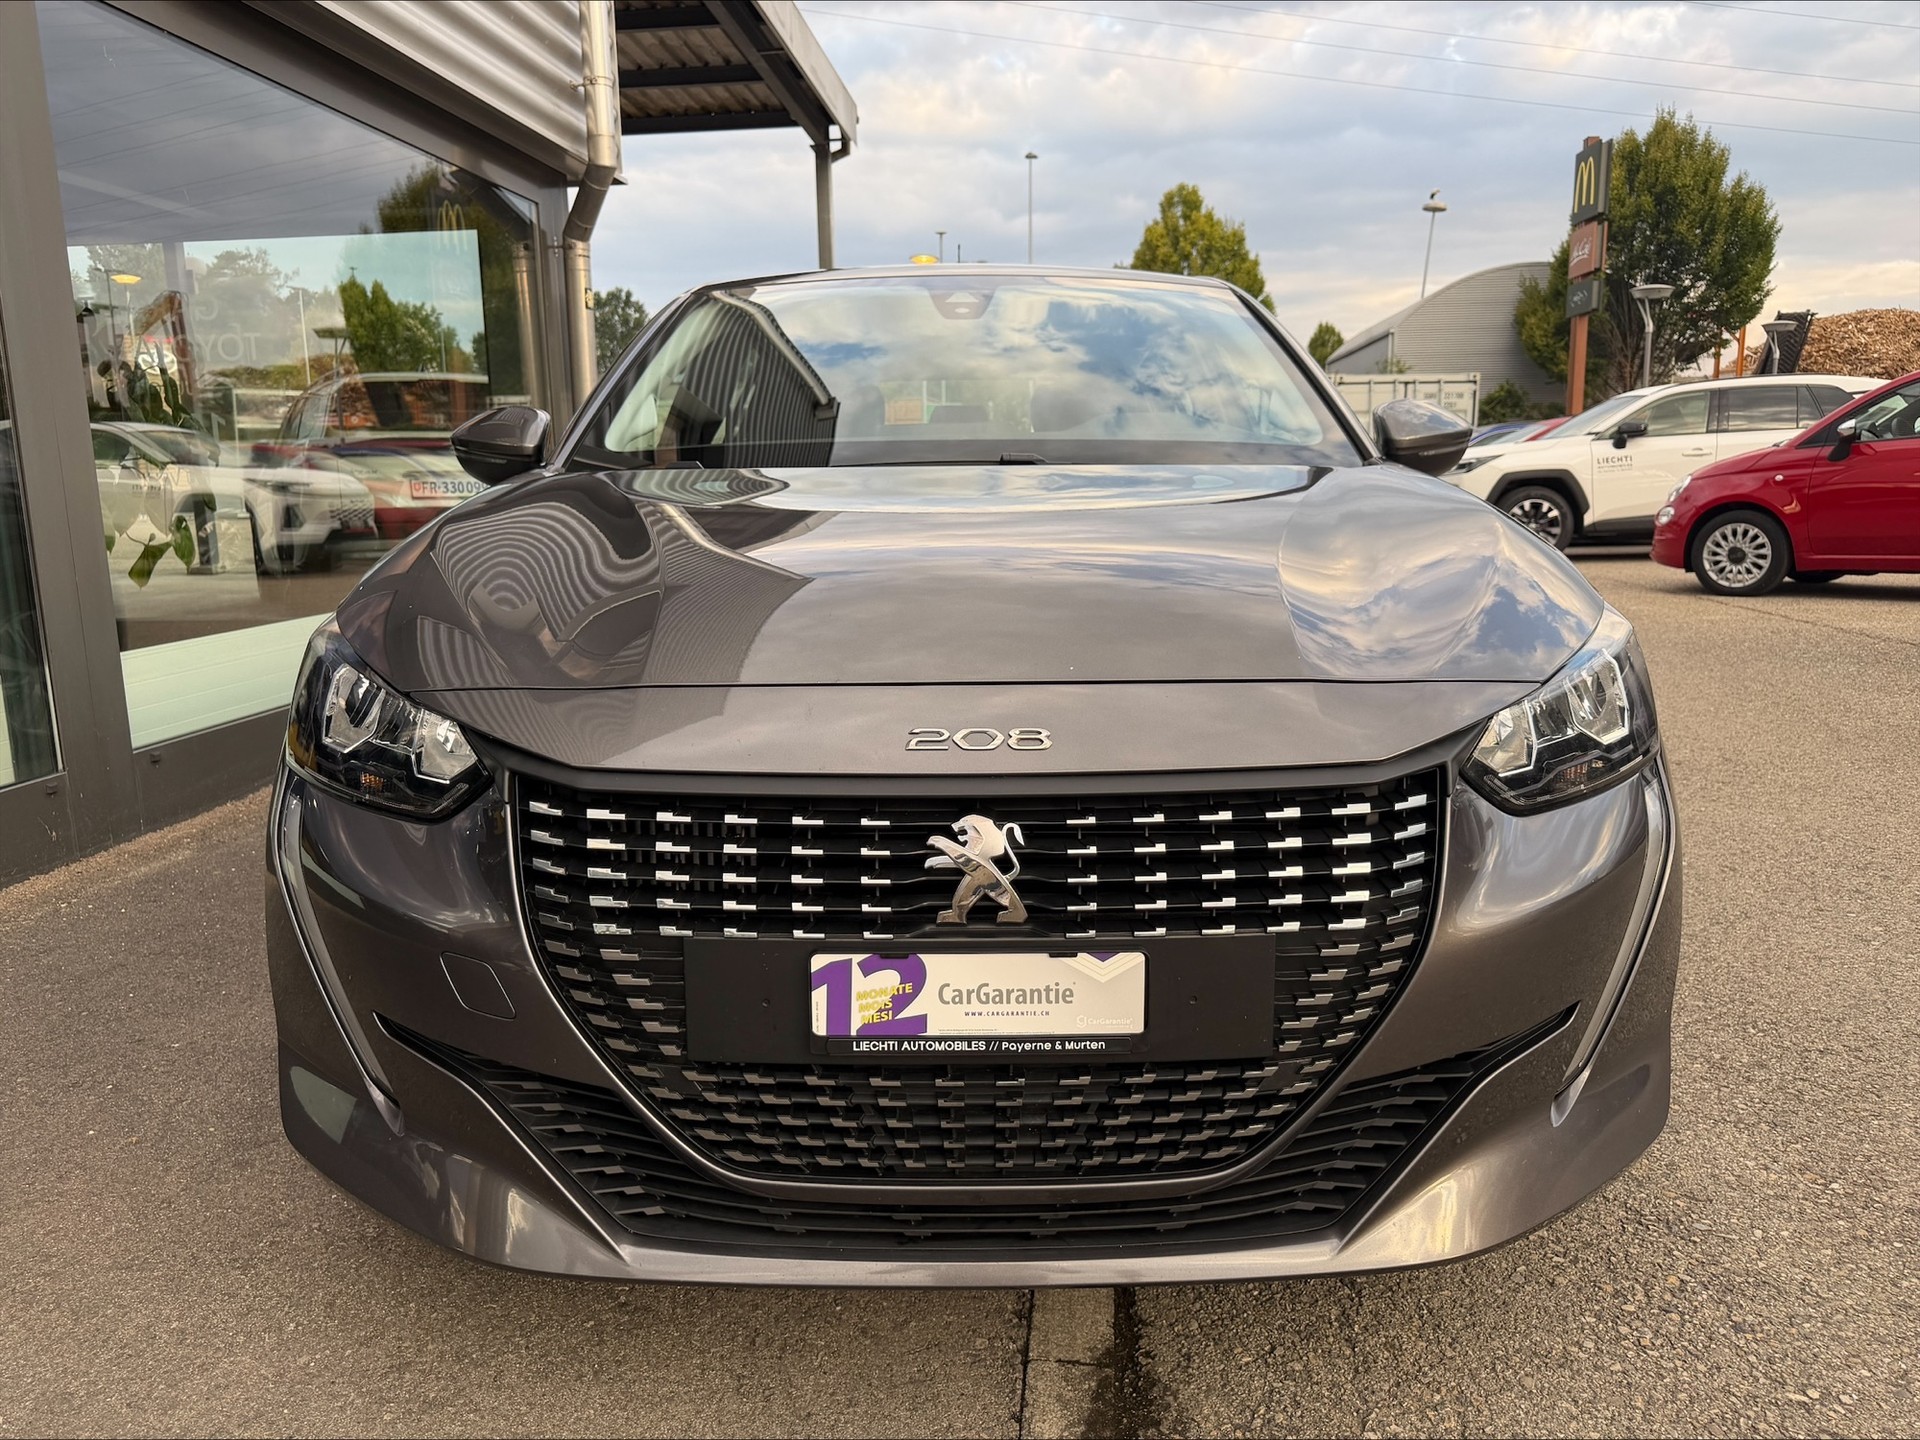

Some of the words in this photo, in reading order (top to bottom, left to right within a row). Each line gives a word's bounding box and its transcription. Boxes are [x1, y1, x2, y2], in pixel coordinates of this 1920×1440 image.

[1597, 455, 1633, 465] LIECHTI
[905, 727, 1053, 751] 208
[811, 953, 928, 1036] 12
[856, 982, 913, 1002] MONATE
[938, 981, 1075, 1005] CarGarantie
[858, 998, 893, 1013] MOIS
[860, 1010, 893, 1025] MESI
[852, 1041, 898, 1051] LIECHTI
[901, 1040, 986, 1051] AUTOMOBILES
[1001, 1041, 1052, 1053] Payerne
[1054, 1040, 1063, 1050] &
[1065, 1039, 1106, 1050] Murten
